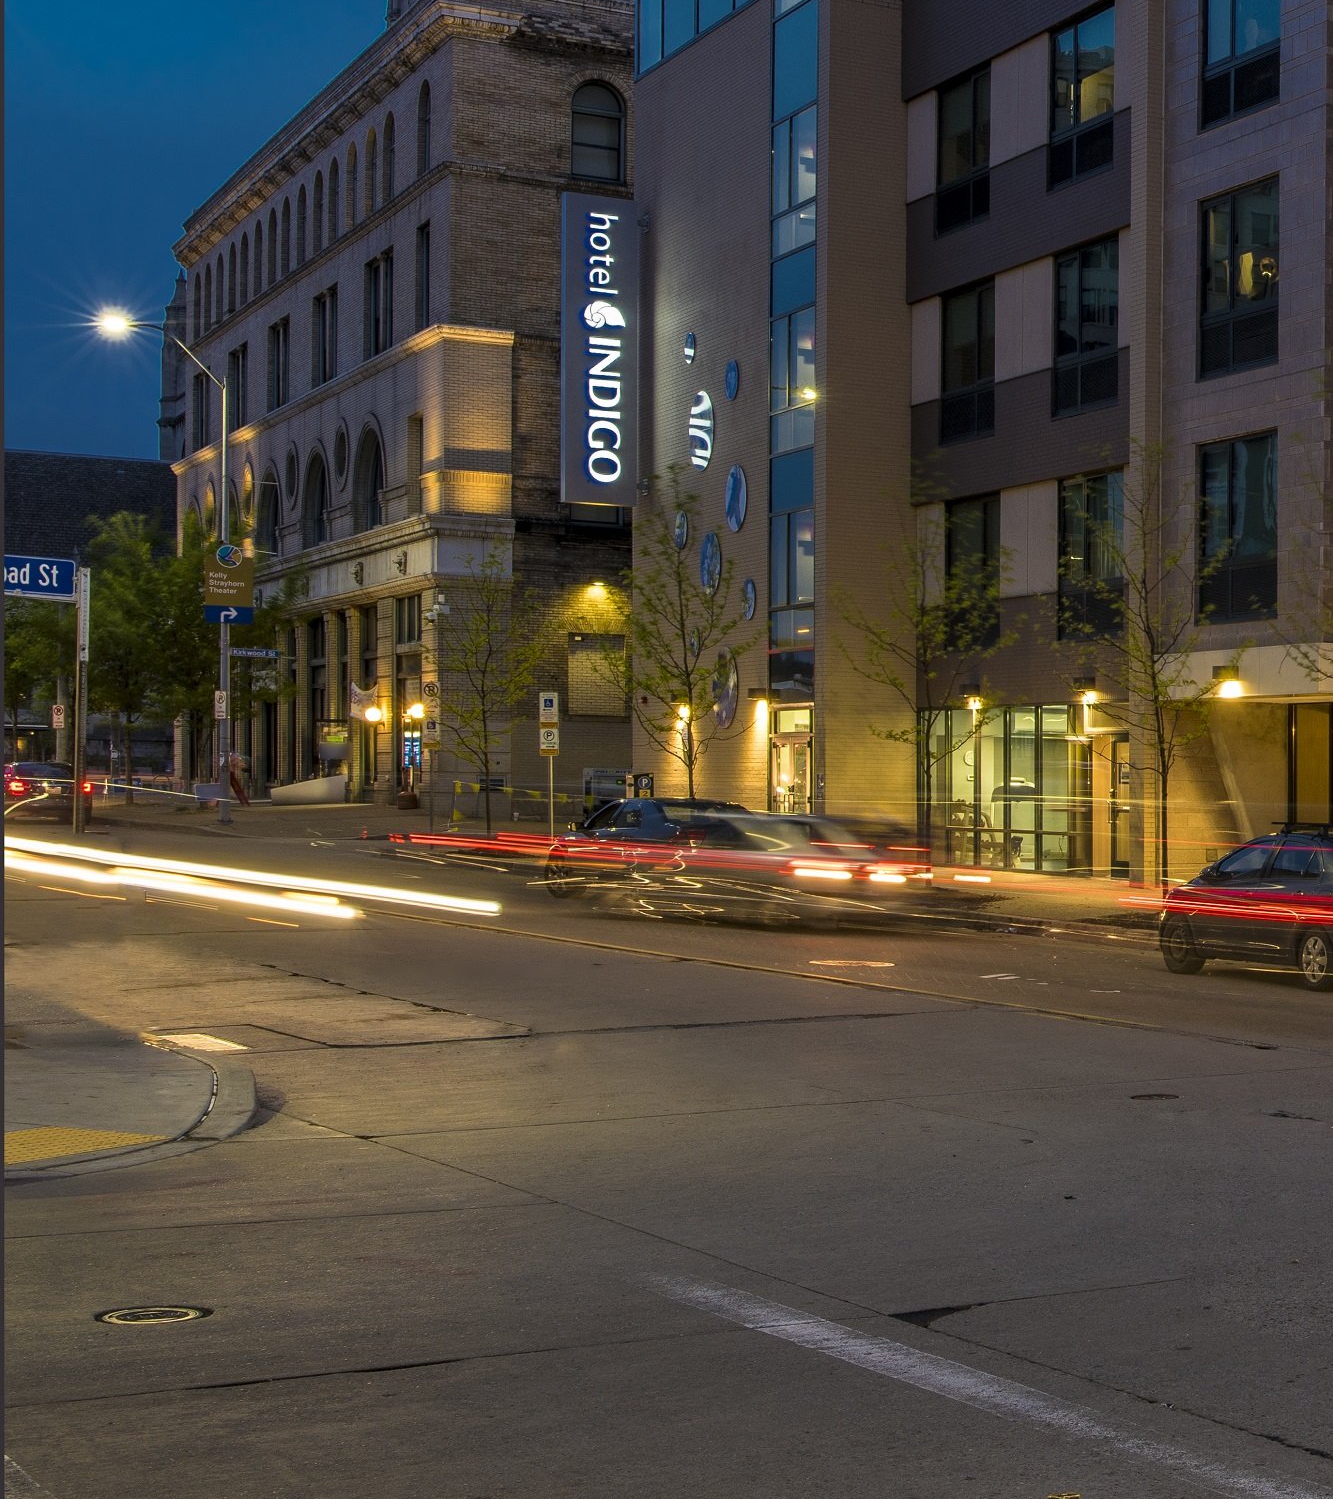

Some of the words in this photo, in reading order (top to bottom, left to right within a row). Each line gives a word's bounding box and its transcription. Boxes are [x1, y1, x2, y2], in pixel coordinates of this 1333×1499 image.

[589, 211, 619, 295] hotel
[588, 336, 622, 483] INDIGO
[38, 564, 59, 587] St
[209, 571, 228, 580] Kelly
[208, 579, 245, 588] Strayhorn
[209, 587, 238, 595] Theater
[233, 649, 266, 657] Kirkwood
